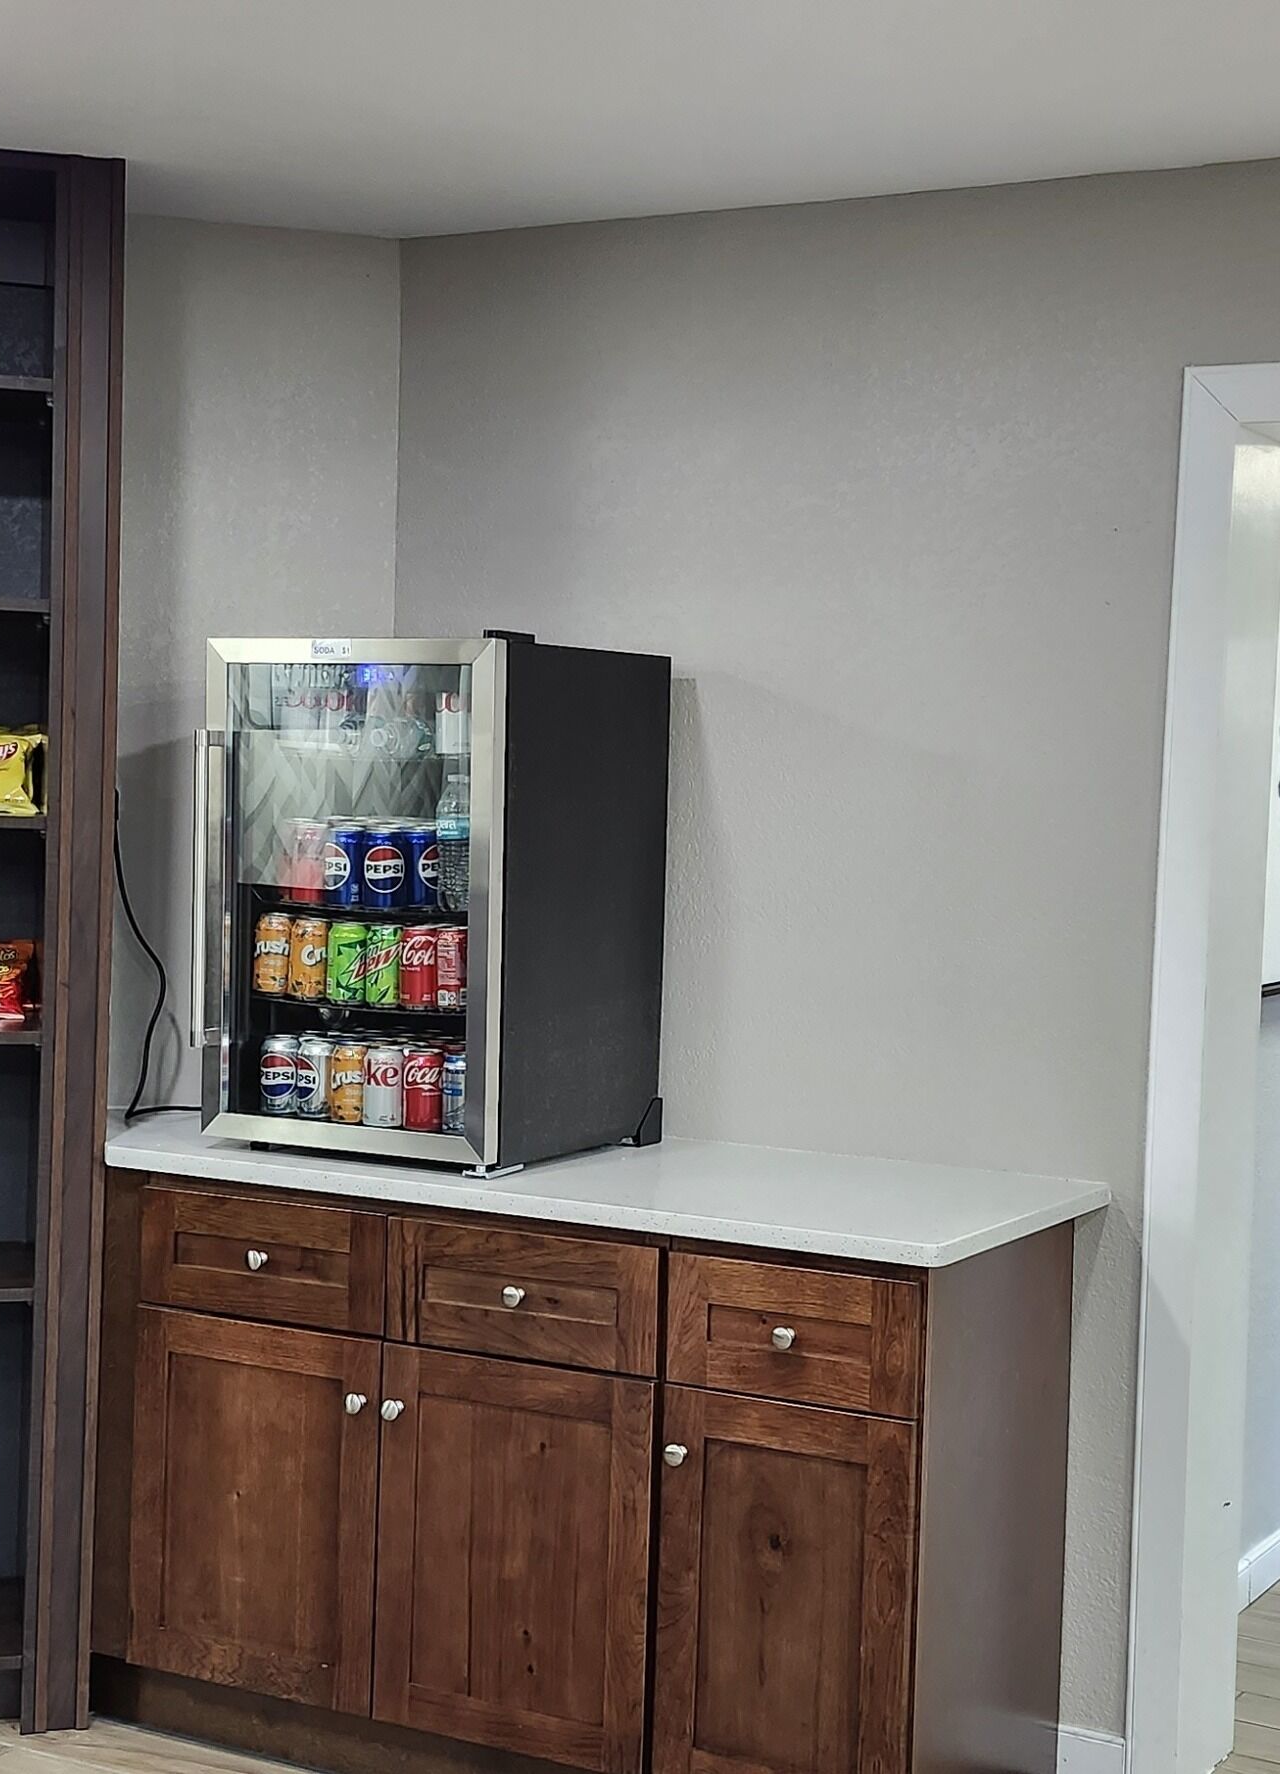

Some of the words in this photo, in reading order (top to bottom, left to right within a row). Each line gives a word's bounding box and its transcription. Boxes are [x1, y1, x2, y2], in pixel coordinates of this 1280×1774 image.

[313, 646, 335, 655] SODA
[327, 861, 347, 872] PSI
[366, 862, 405, 875] PEPSI
[256, 937, 289, 957] rush
[366, 1058, 399, 1087] ke
[299, 1074, 316, 1086] PSI
